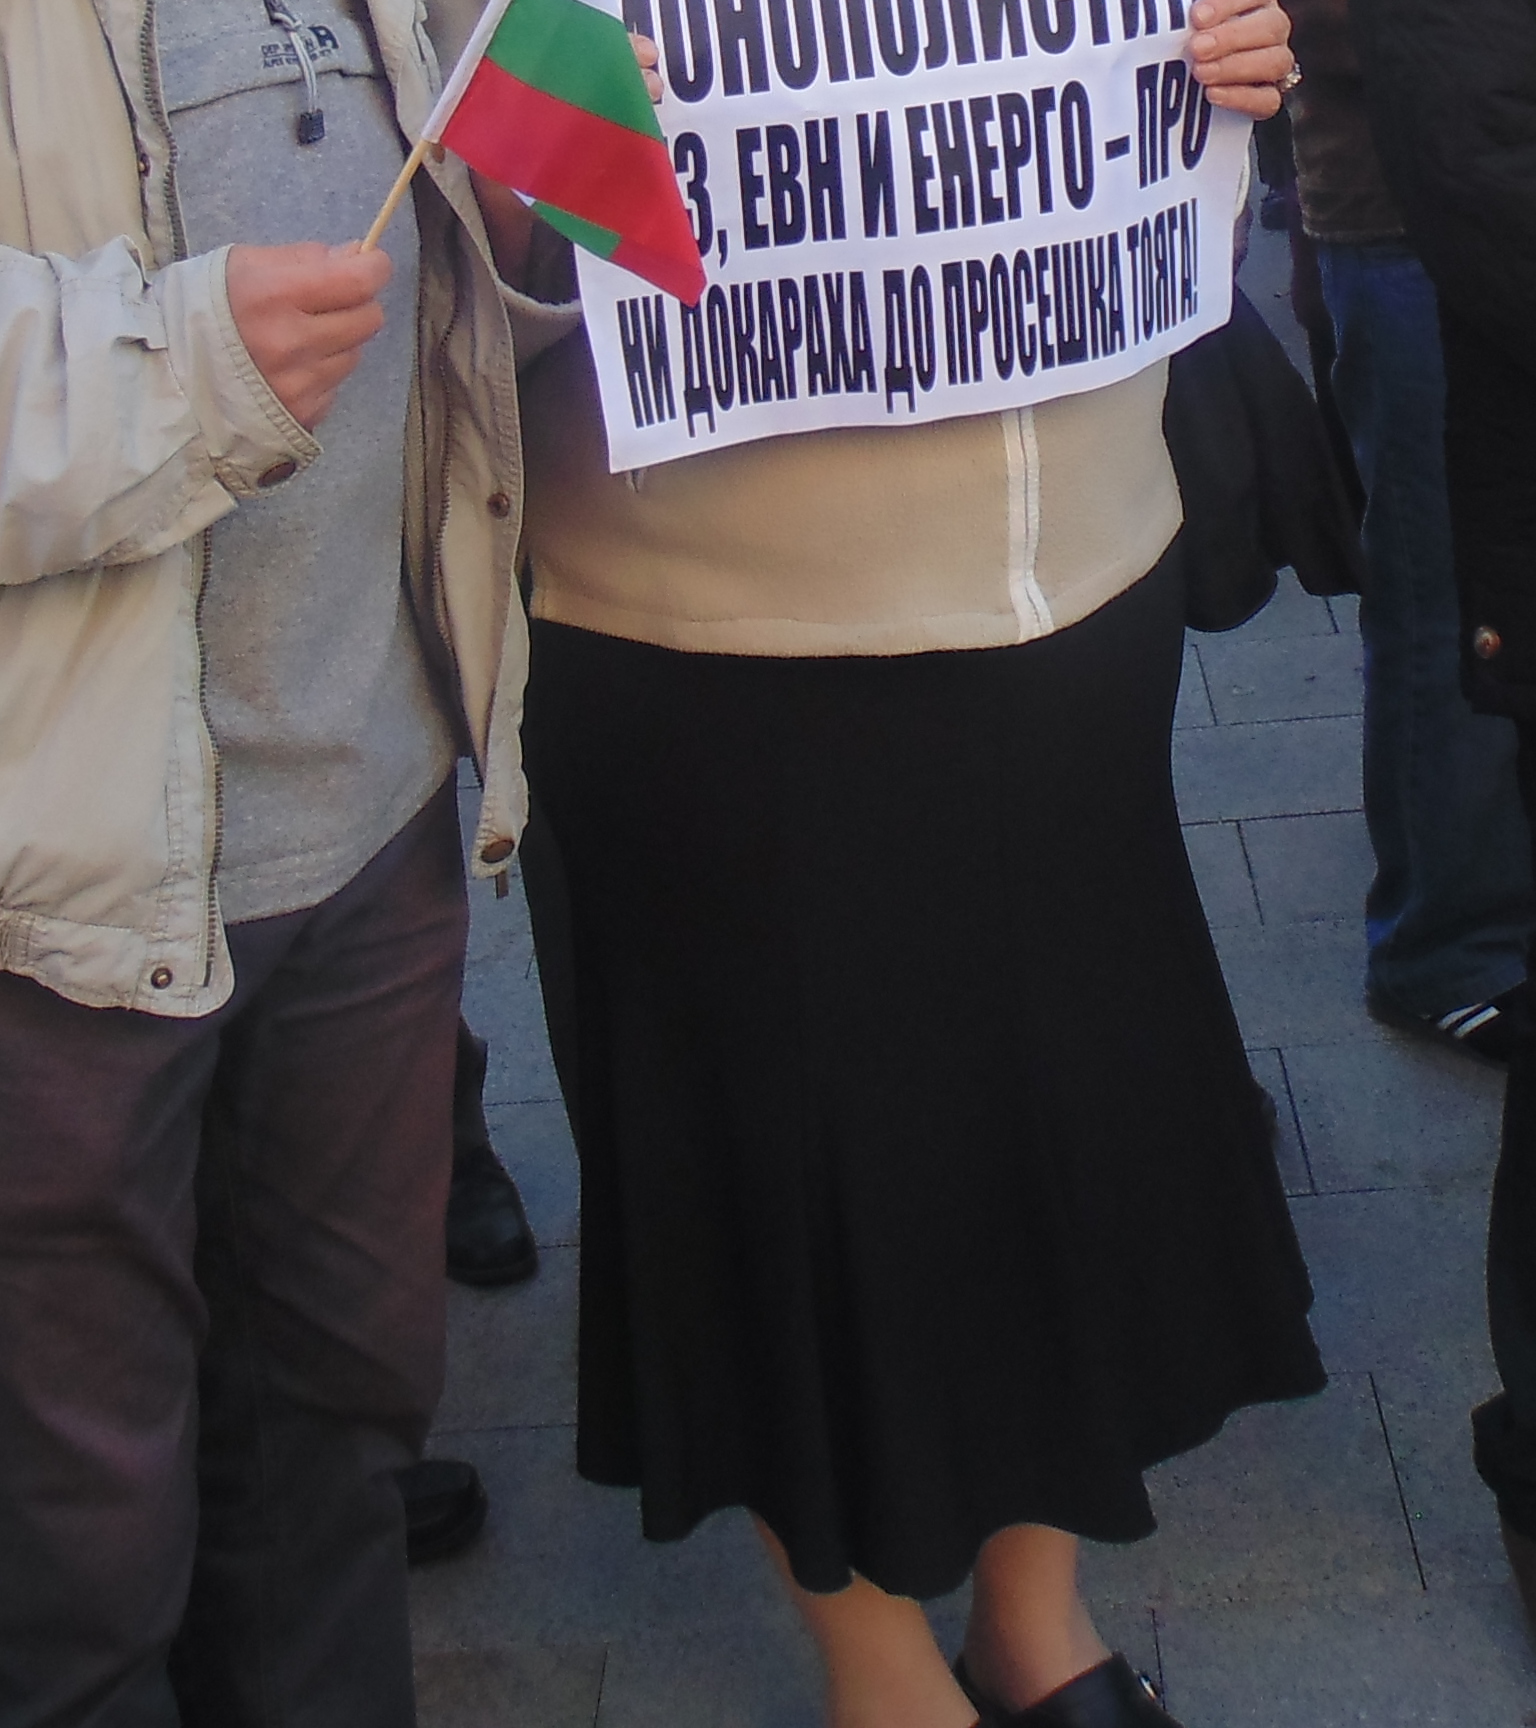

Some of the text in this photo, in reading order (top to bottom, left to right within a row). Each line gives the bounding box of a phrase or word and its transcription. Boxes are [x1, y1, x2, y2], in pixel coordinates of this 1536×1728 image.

[736, 116, 848, 251] ЕВН
[855, 110, 898, 239] И
[906, 80, 1095, 235] ЕНЕРГО
[1135, 58, 1212, 190] ПРО
[616, 197, 1200, 439] НИ ДОКАРАХА ДО ПРОСЕШКА ТОЯГА!
